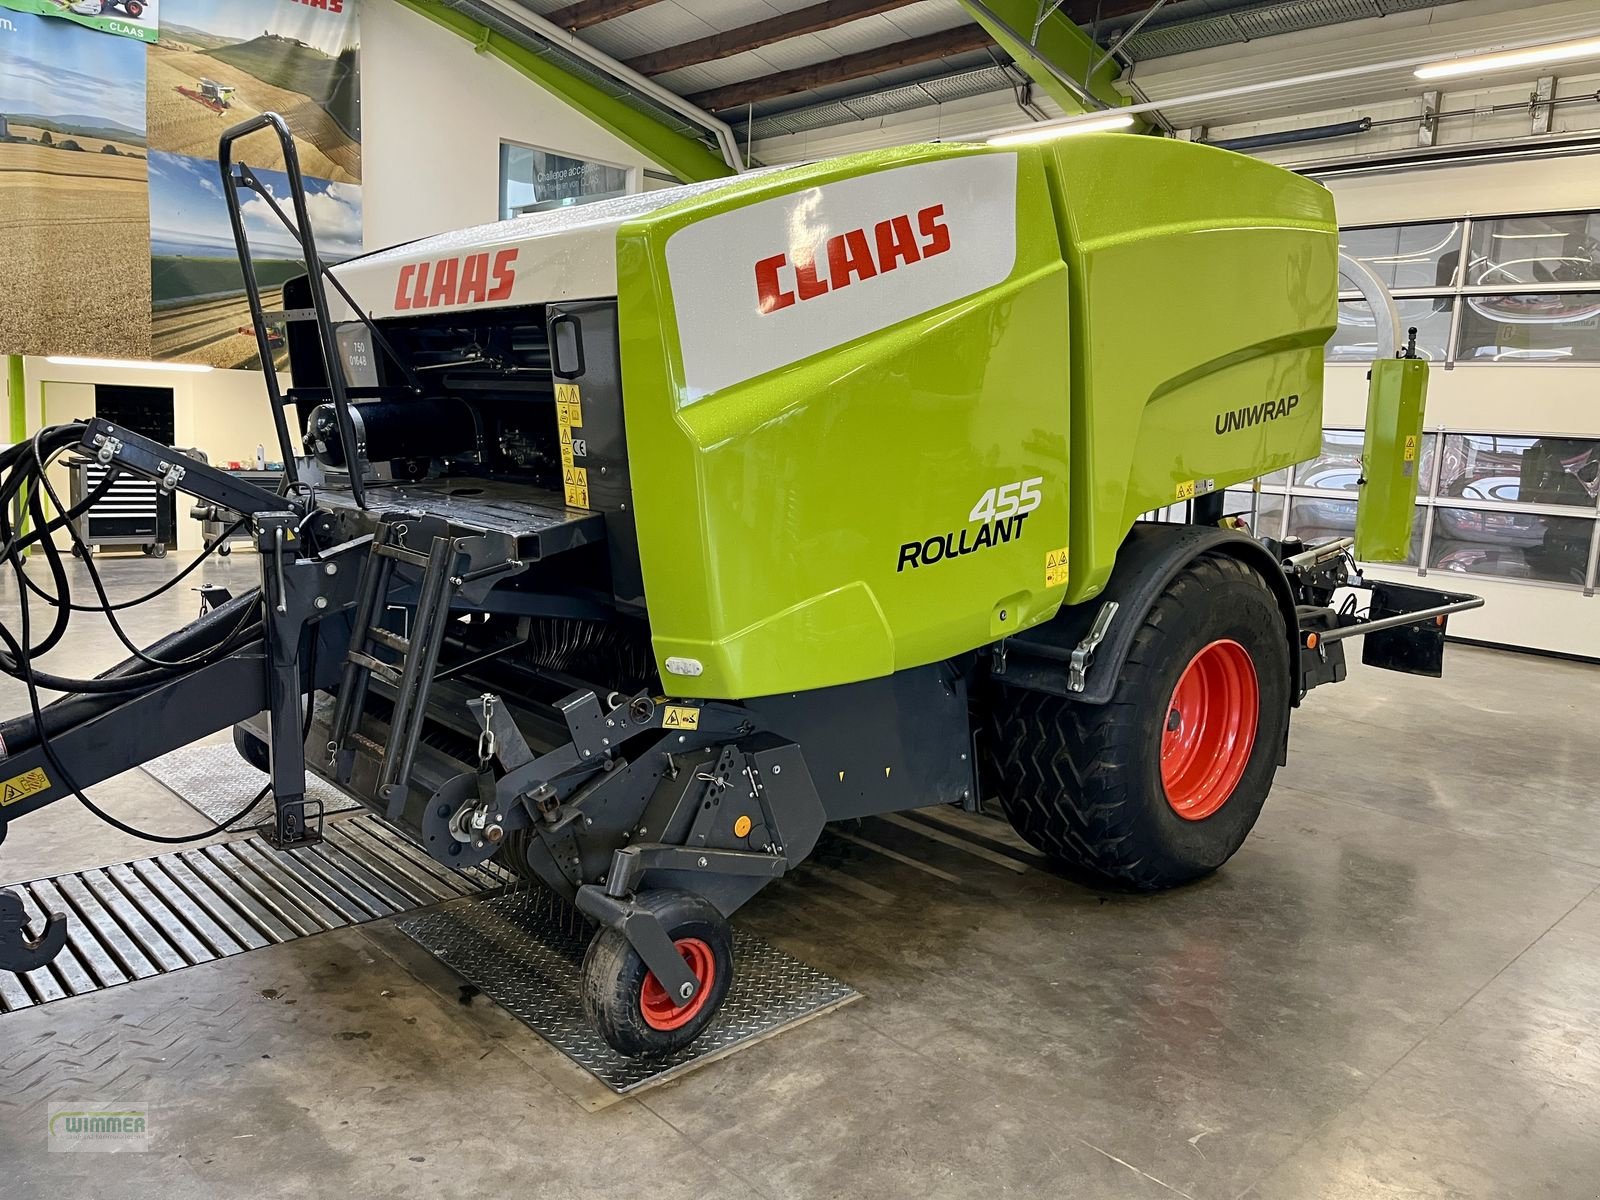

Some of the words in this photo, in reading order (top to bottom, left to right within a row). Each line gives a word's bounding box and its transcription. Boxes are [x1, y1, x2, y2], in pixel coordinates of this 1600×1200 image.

[109, 22, 145, 38] CLAAS
[537, 169, 567, 183] Challenge
[394, 247, 520, 311] CLAAS
[754, 203, 952, 315] CLAAS
[1215, 394, 1299, 435] UNIWRAP
[968, 476, 1044, 524] 455
[896, 511, 1029, 573] ROLLANT
